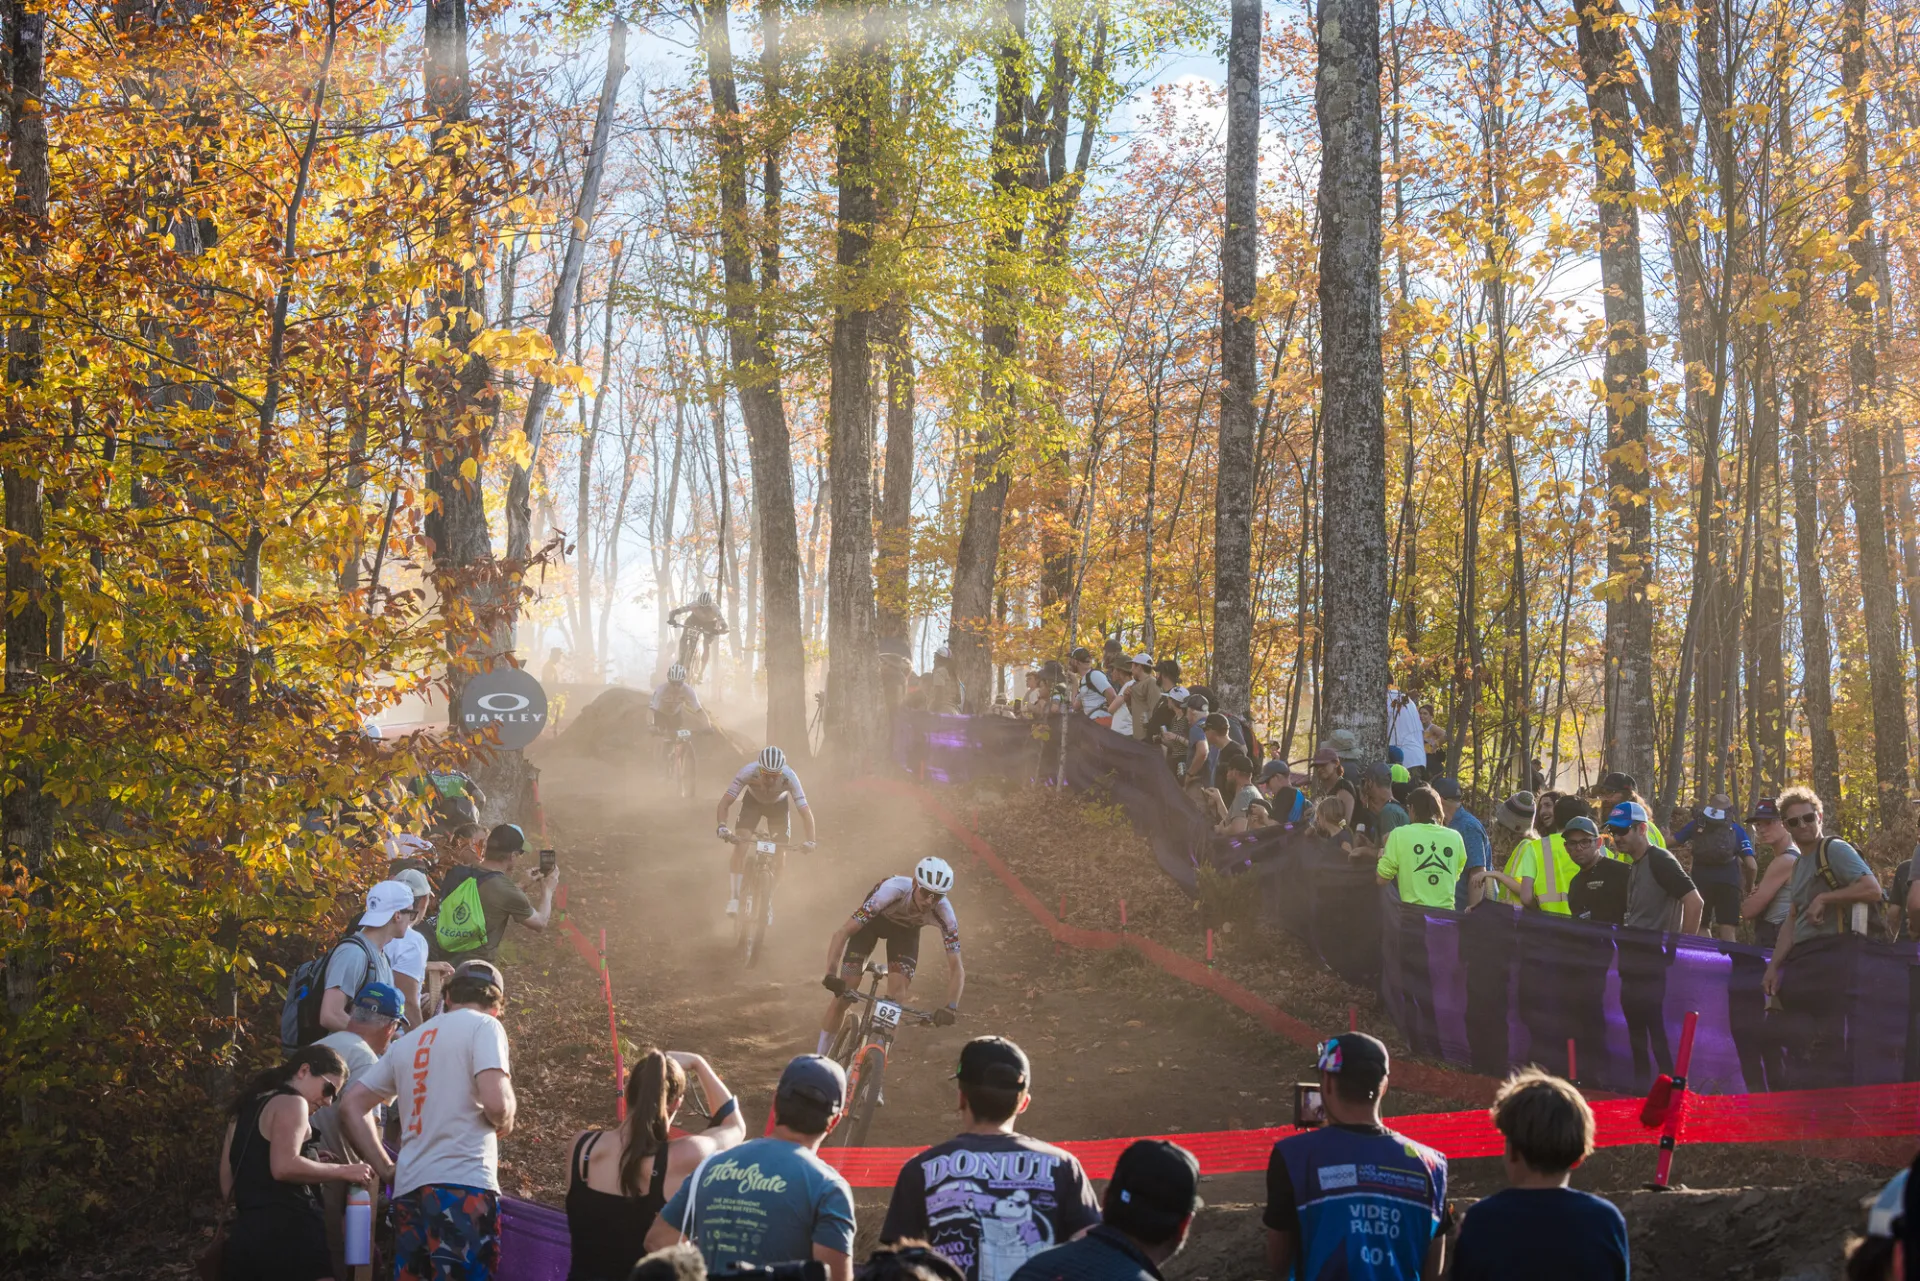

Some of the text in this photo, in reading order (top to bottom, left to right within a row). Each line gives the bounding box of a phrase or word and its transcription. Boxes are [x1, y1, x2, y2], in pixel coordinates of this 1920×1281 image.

[465, 713, 542, 722] OAKLEY
[440, 926, 474, 938] LEGACY
[879, 1006, 896, 1021] 62
[921, 1149, 1060, 1191] DONUT
[1349, 1204, 1401, 1223] VIDEO
[1350, 1219, 1400, 1239] RADIO
[1360, 1245, 1394, 1266] 001
